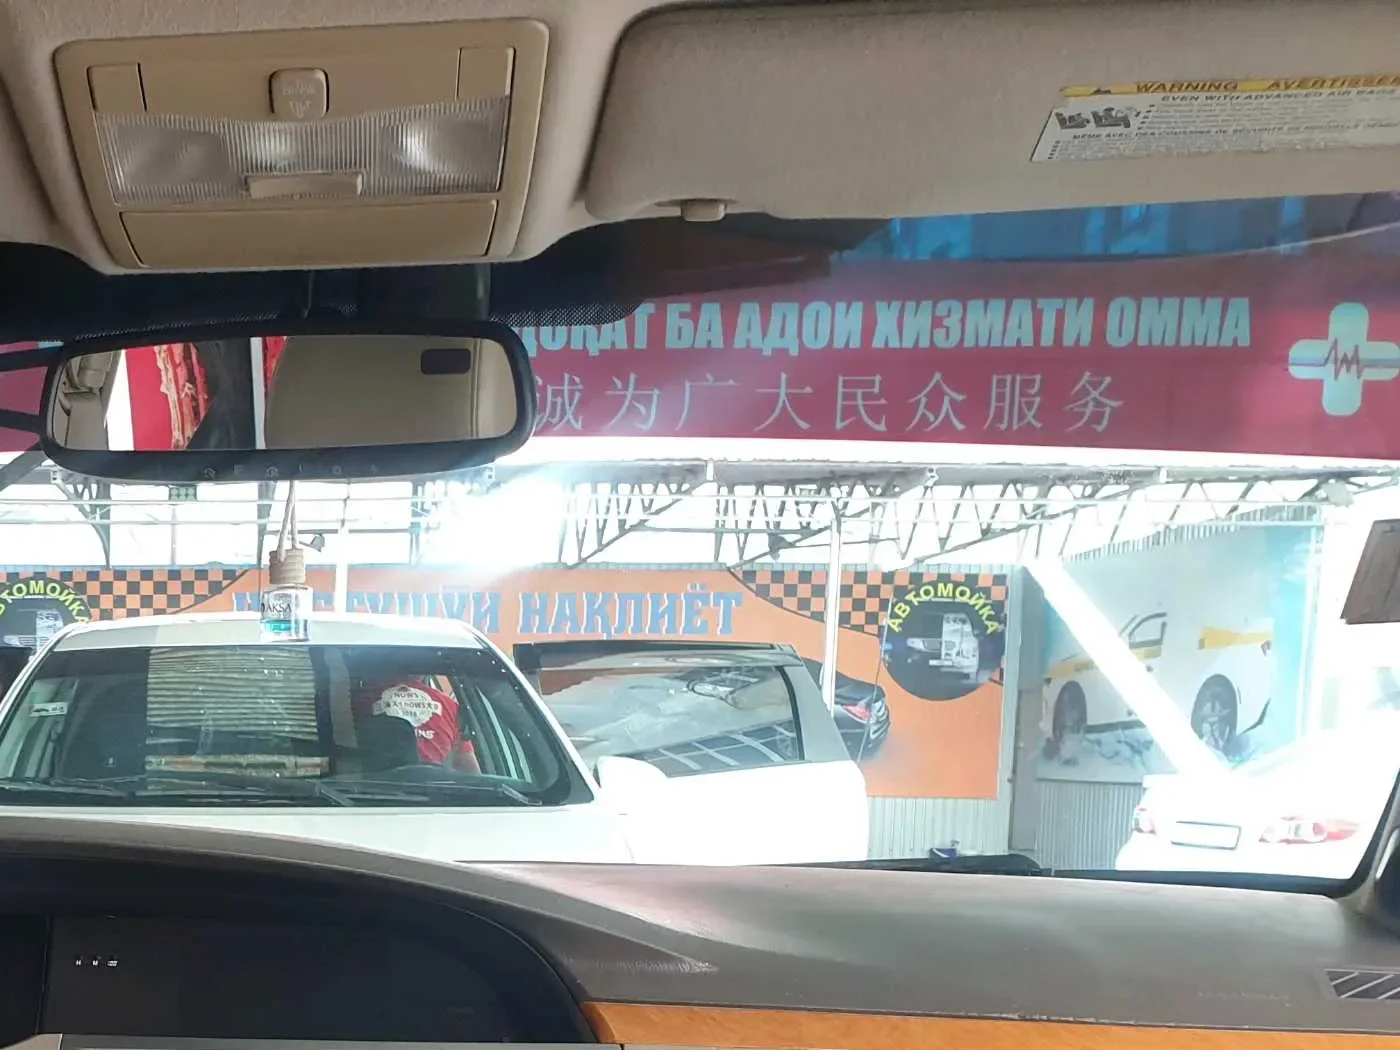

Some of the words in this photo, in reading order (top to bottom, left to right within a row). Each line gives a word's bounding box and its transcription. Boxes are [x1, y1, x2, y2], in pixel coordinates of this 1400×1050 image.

[1136, 80, 1241, 93] WARNING
[665, 302, 724, 349] БА
[733, 301, 864, 357] АДОИ
[872, 298, 1095, 349] ХИЗМАТИ
[1105, 296, 1252, 347] ОММА
[886, 582, 1001, 635] АВТОМОЙКА
